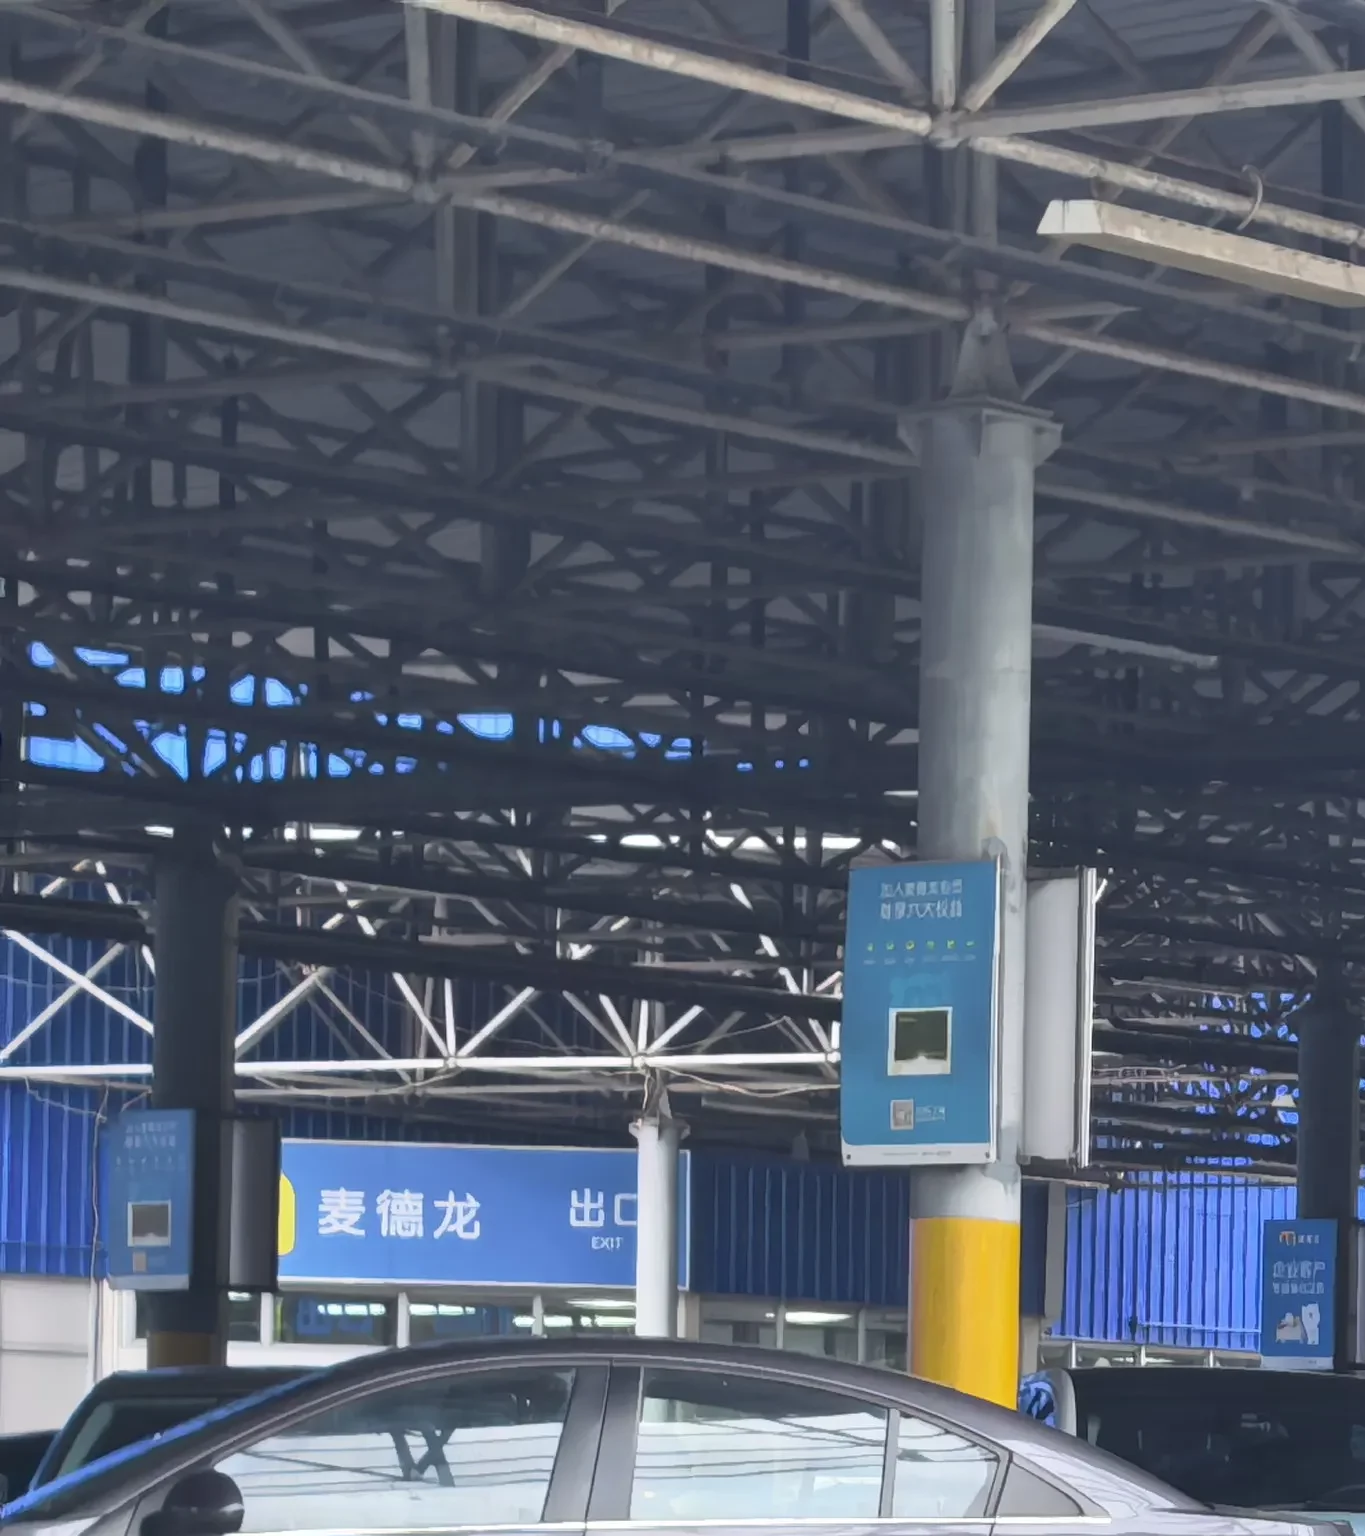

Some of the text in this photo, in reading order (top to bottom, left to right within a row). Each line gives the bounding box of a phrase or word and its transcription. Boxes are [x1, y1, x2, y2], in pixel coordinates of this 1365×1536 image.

[318, 1186, 637, 1240] 麦德龙 出口
[591, 1236, 623, 1251] EXIT
